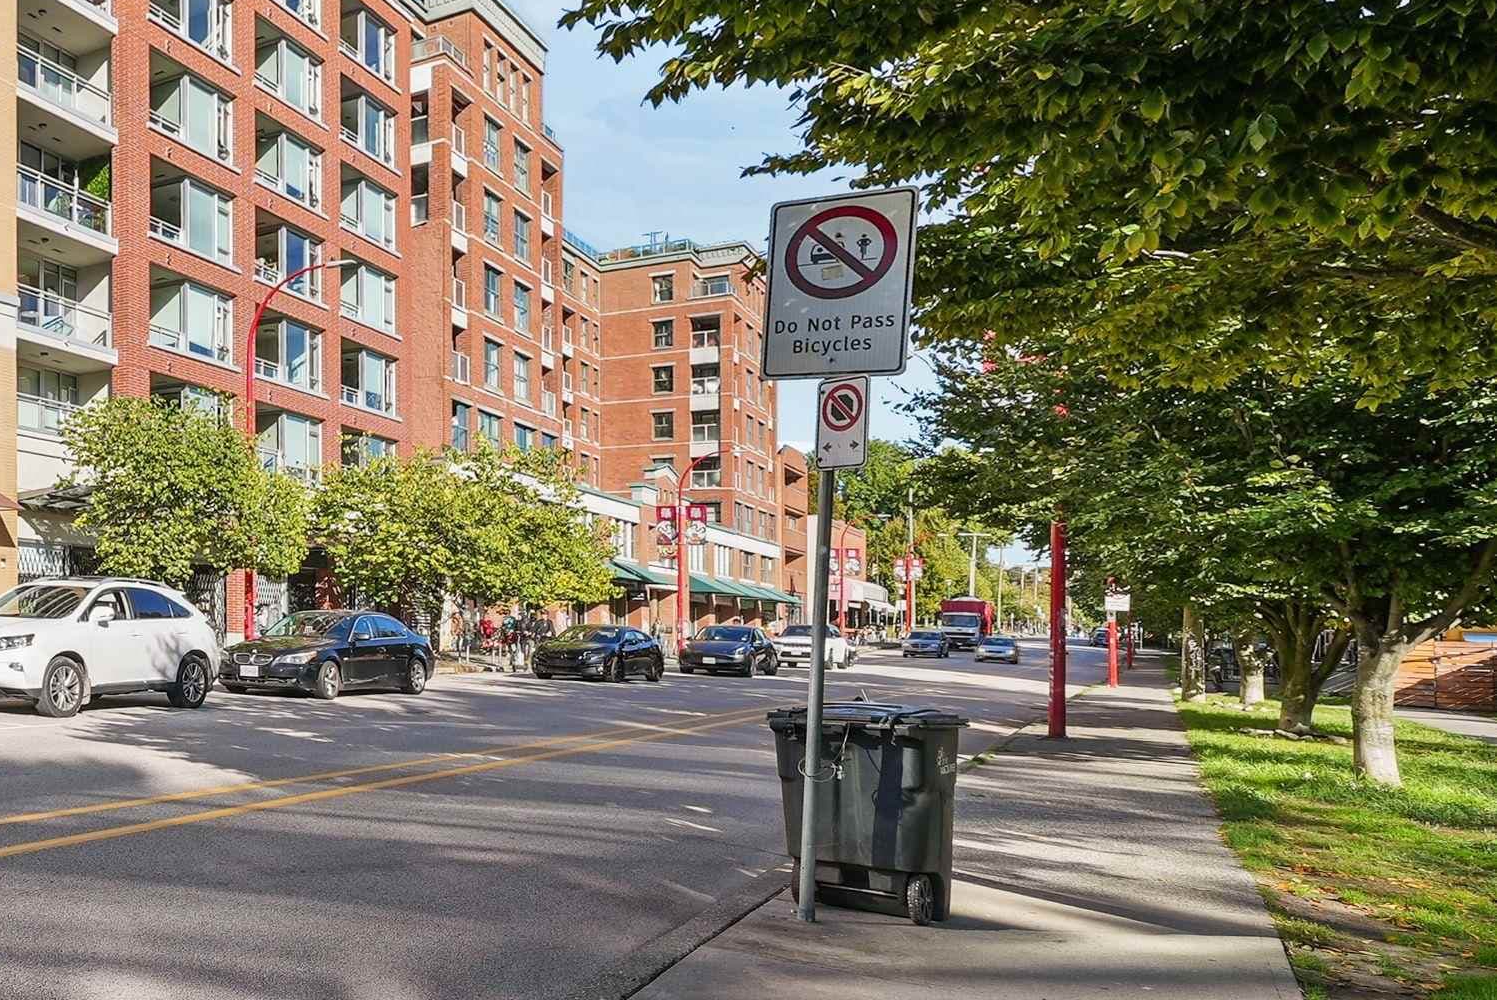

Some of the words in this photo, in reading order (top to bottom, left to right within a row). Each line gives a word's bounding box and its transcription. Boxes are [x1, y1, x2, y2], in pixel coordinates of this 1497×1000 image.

[775, 319, 798, 334] Do
[808, 316, 841, 332] Not
[851, 314, 895, 329] Pass
[793, 336, 872, 356] Bicycles
